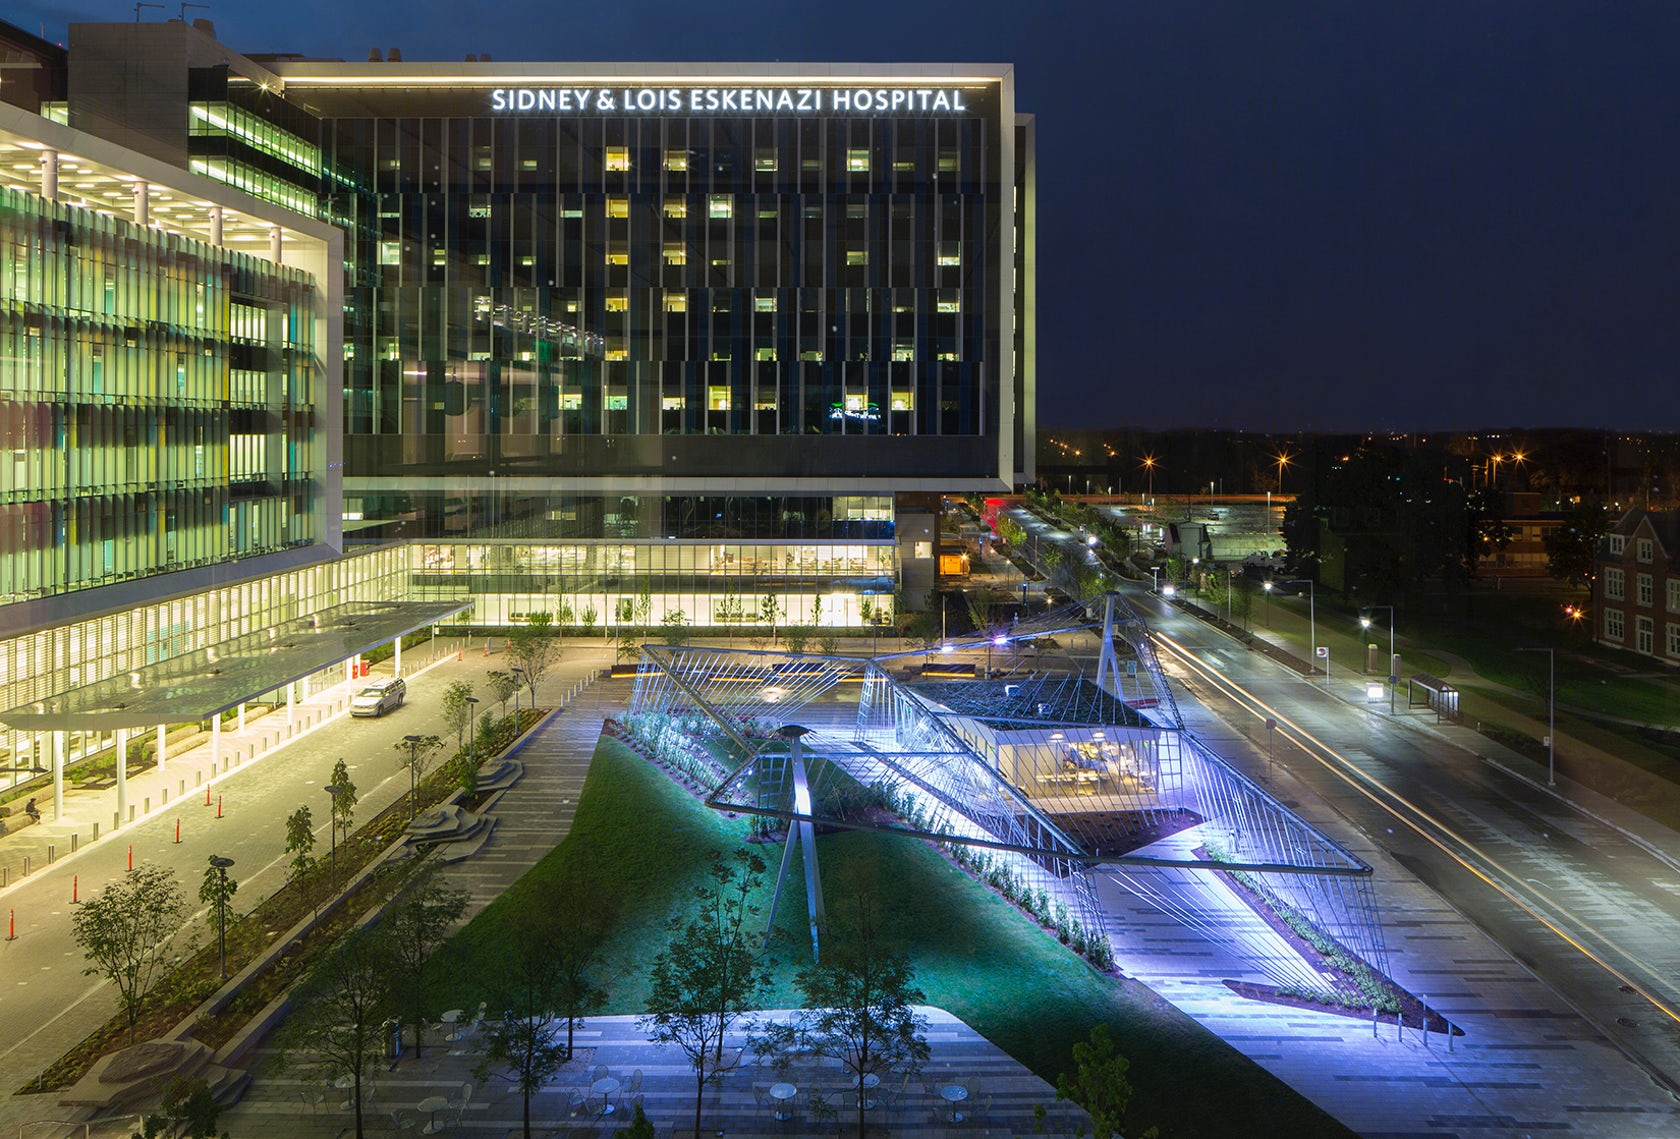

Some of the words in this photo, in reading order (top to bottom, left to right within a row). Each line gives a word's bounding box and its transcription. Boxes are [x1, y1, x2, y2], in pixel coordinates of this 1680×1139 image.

[492, 88, 590, 110] SIDNEY
[596, 88, 616, 110] &
[624, 88, 681, 110] LOIS
[691, 88, 821, 111] ESKENAZI
[832, 89, 966, 111] HOSPITAL
